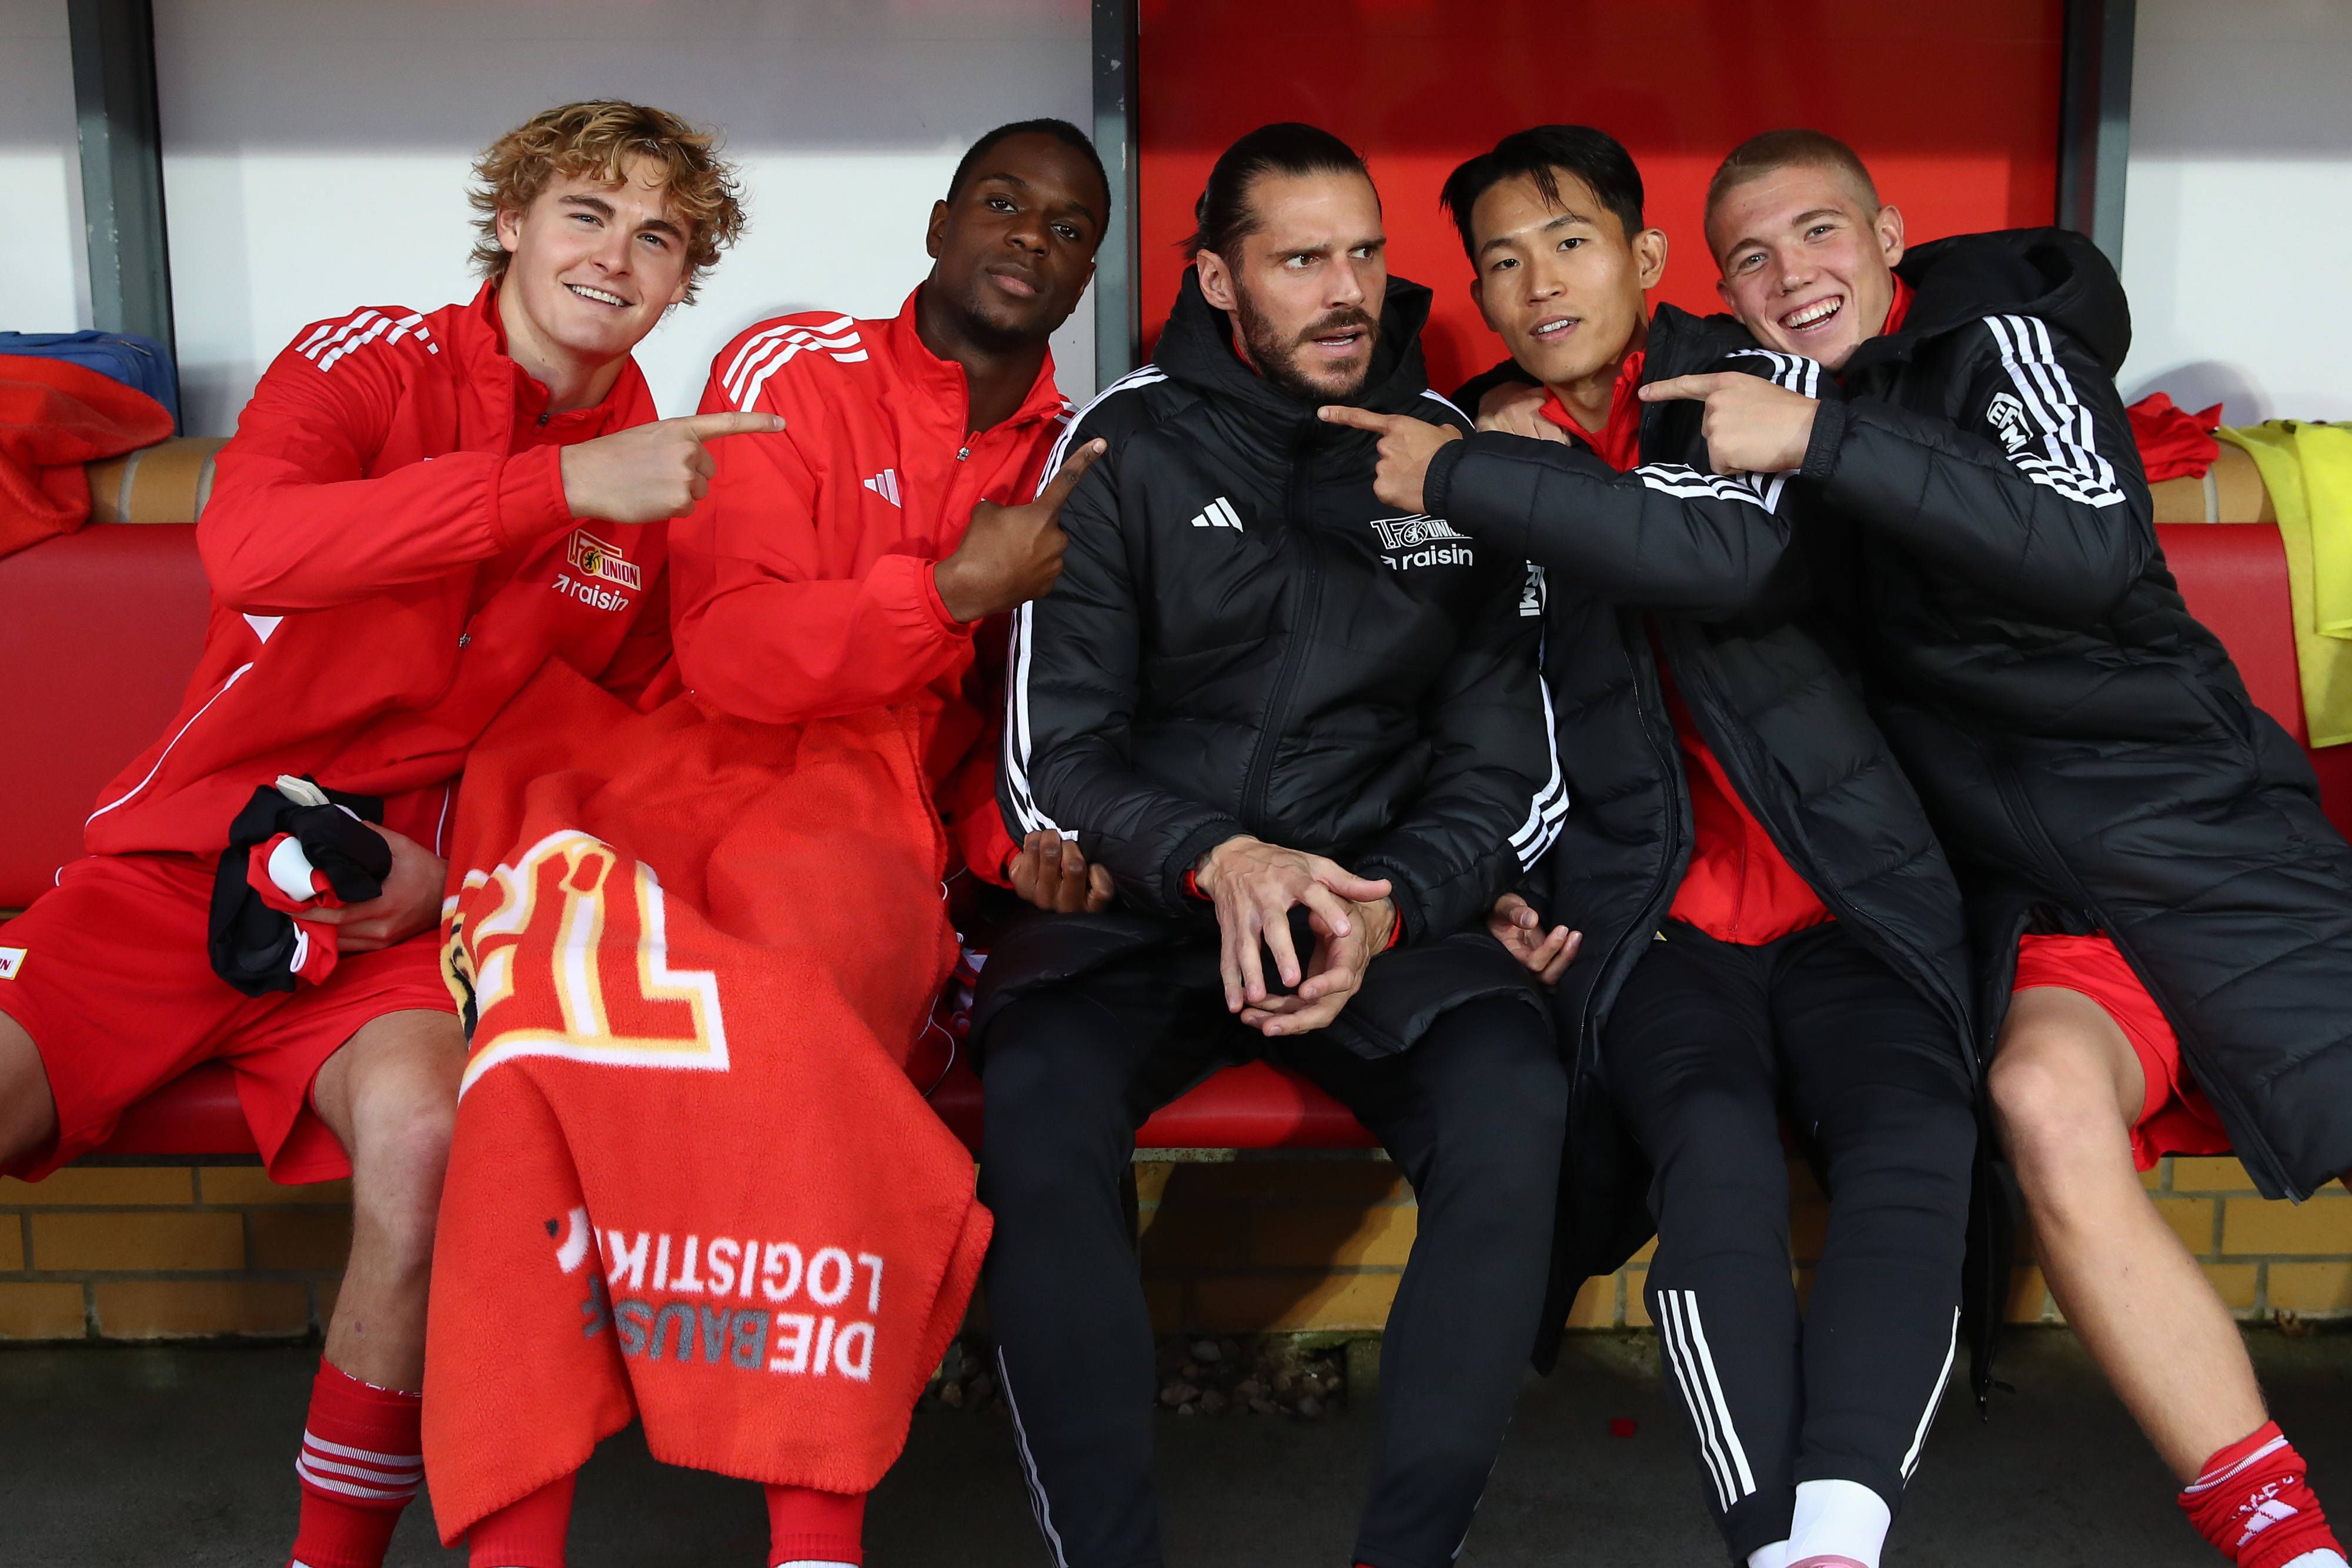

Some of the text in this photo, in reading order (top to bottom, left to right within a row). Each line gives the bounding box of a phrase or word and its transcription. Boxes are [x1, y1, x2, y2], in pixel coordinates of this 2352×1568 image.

[1426, 521, 1464, 537] UNI
[1402, 543, 1473, 570] raisin
[602, 557, 638, 587] UNION
[569, 580, 629, 611] raisin
[1519, 560, 1541, 616] RMI
[608, 1229, 883, 1316] LOGISTIK
